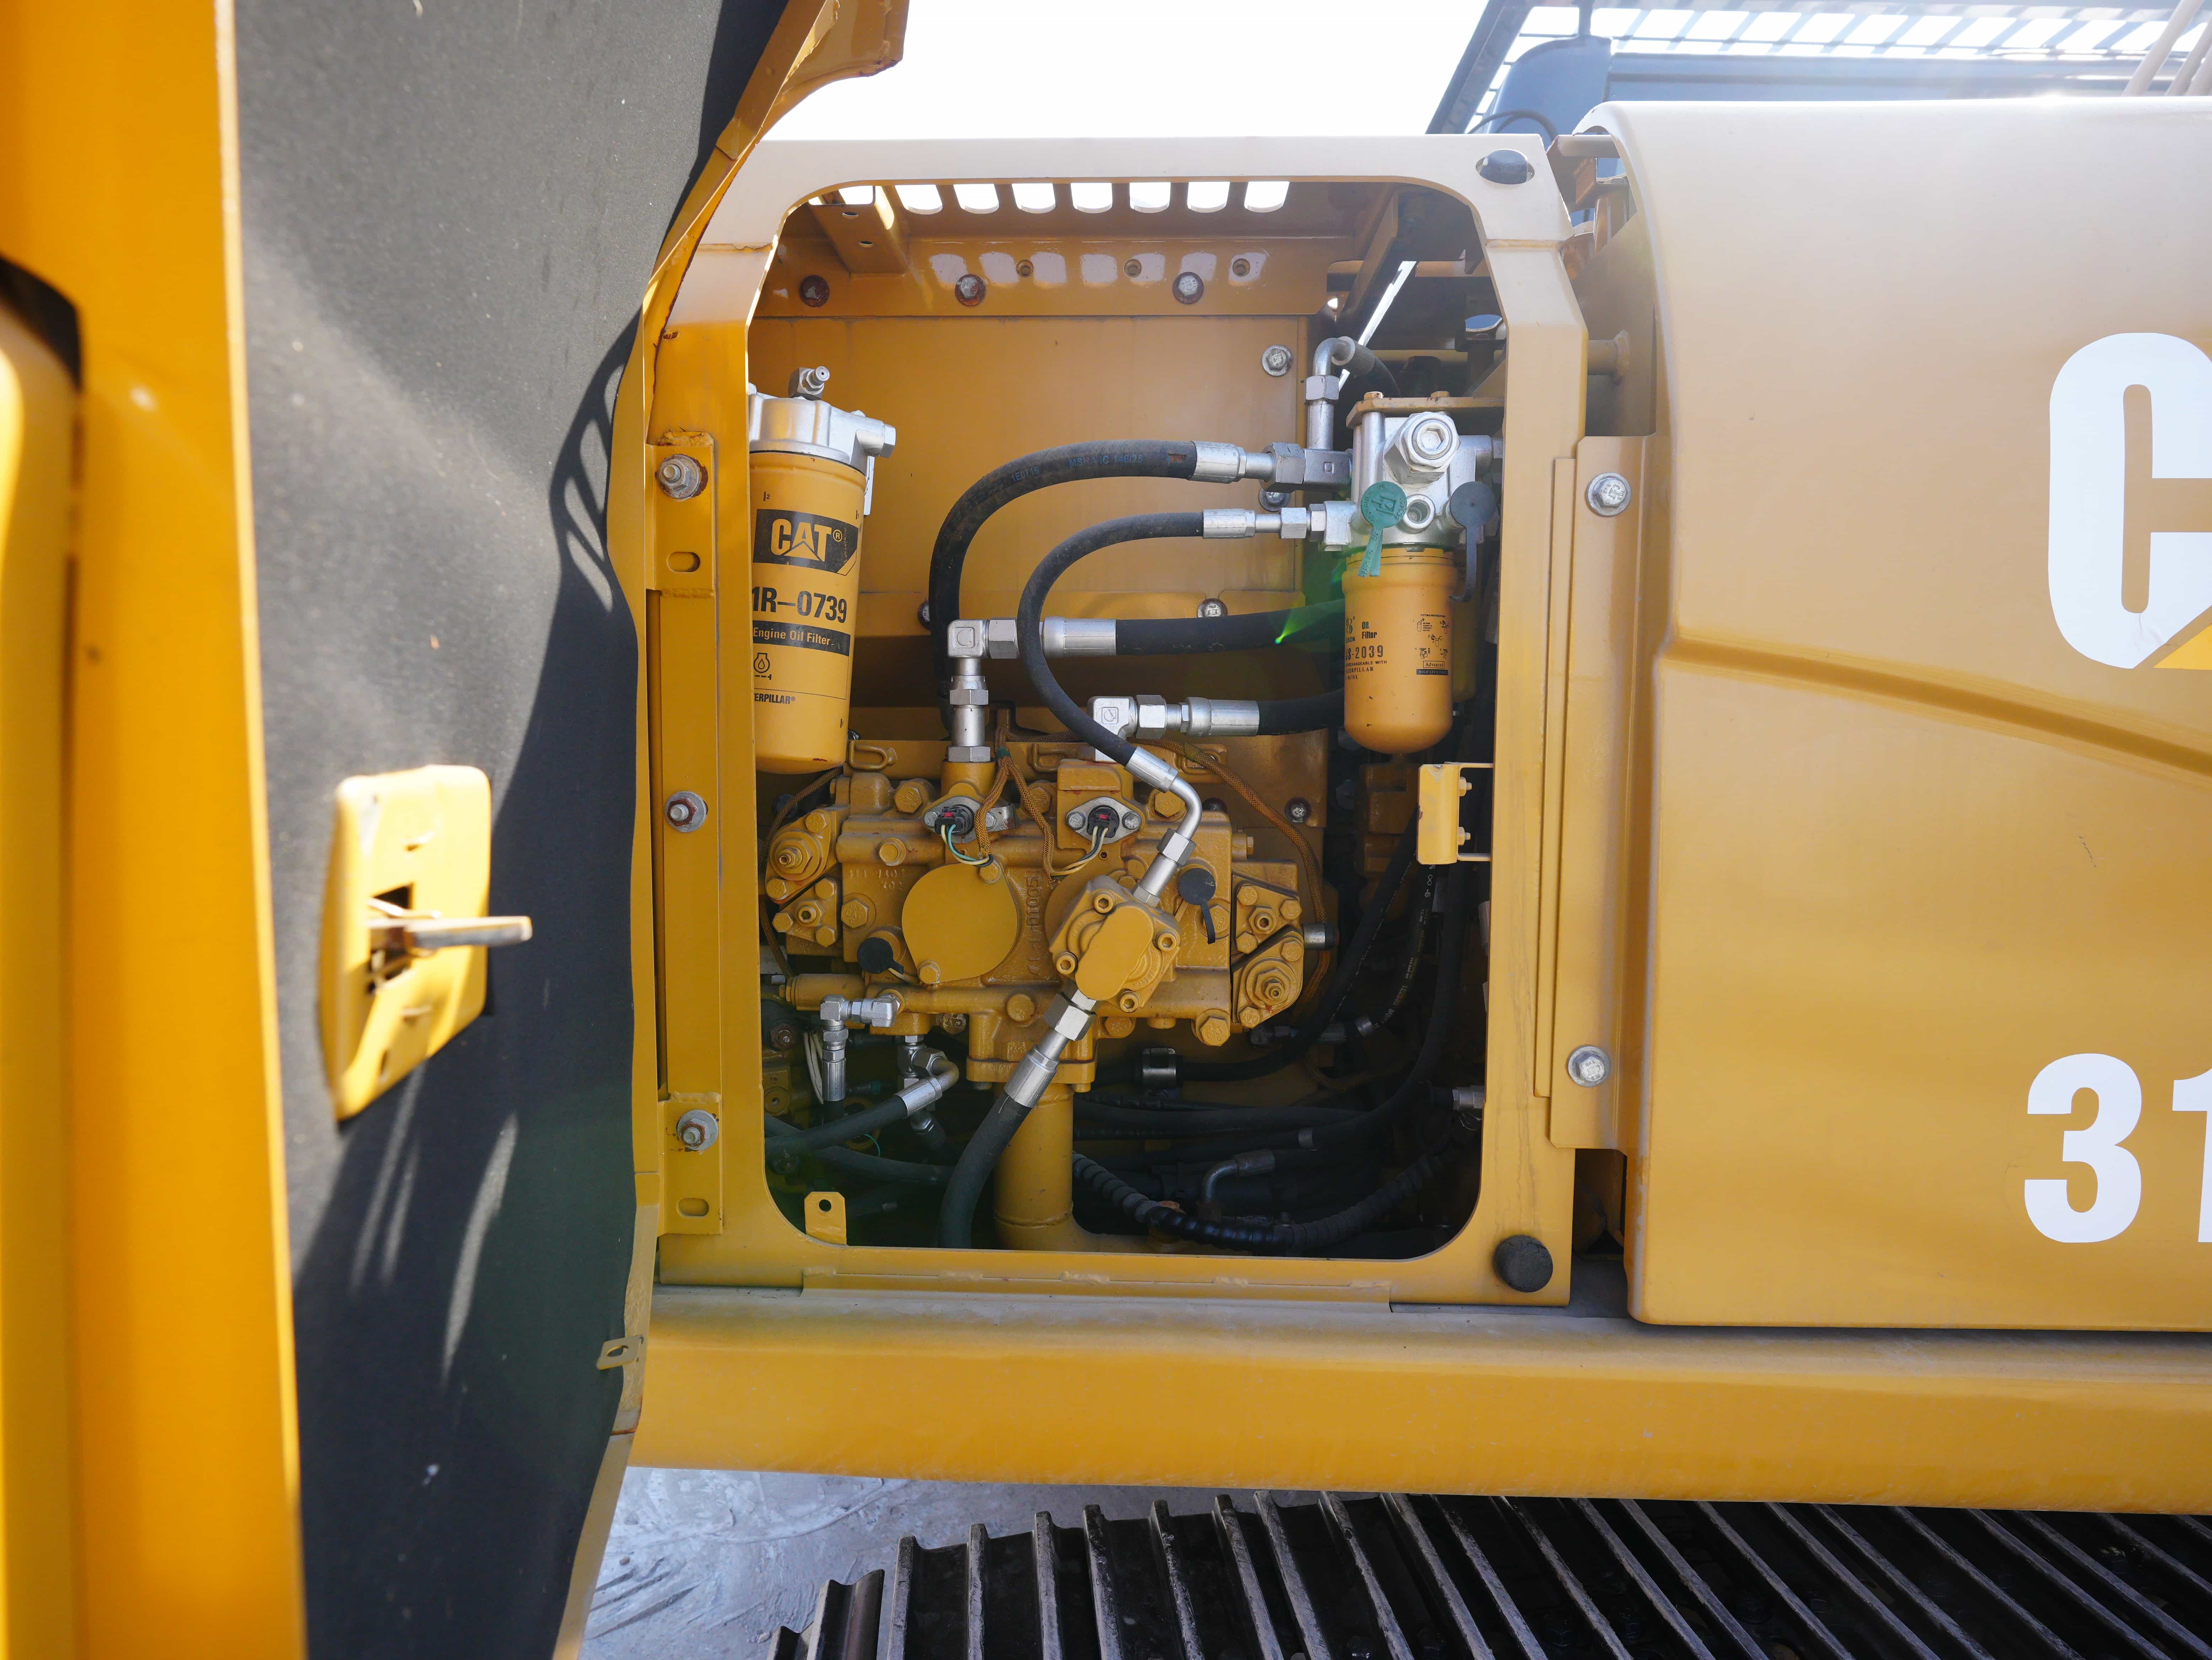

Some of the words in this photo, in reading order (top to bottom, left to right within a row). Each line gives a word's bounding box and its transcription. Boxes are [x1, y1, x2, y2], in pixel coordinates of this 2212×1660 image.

[2048, 333, 2212, 669] C
[753, 627, 786, 640] Engine
[790, 630, 804, 642] Oil
[807, 632, 831, 645] Filter
[754, 693, 796, 705] ERPILLAR®
